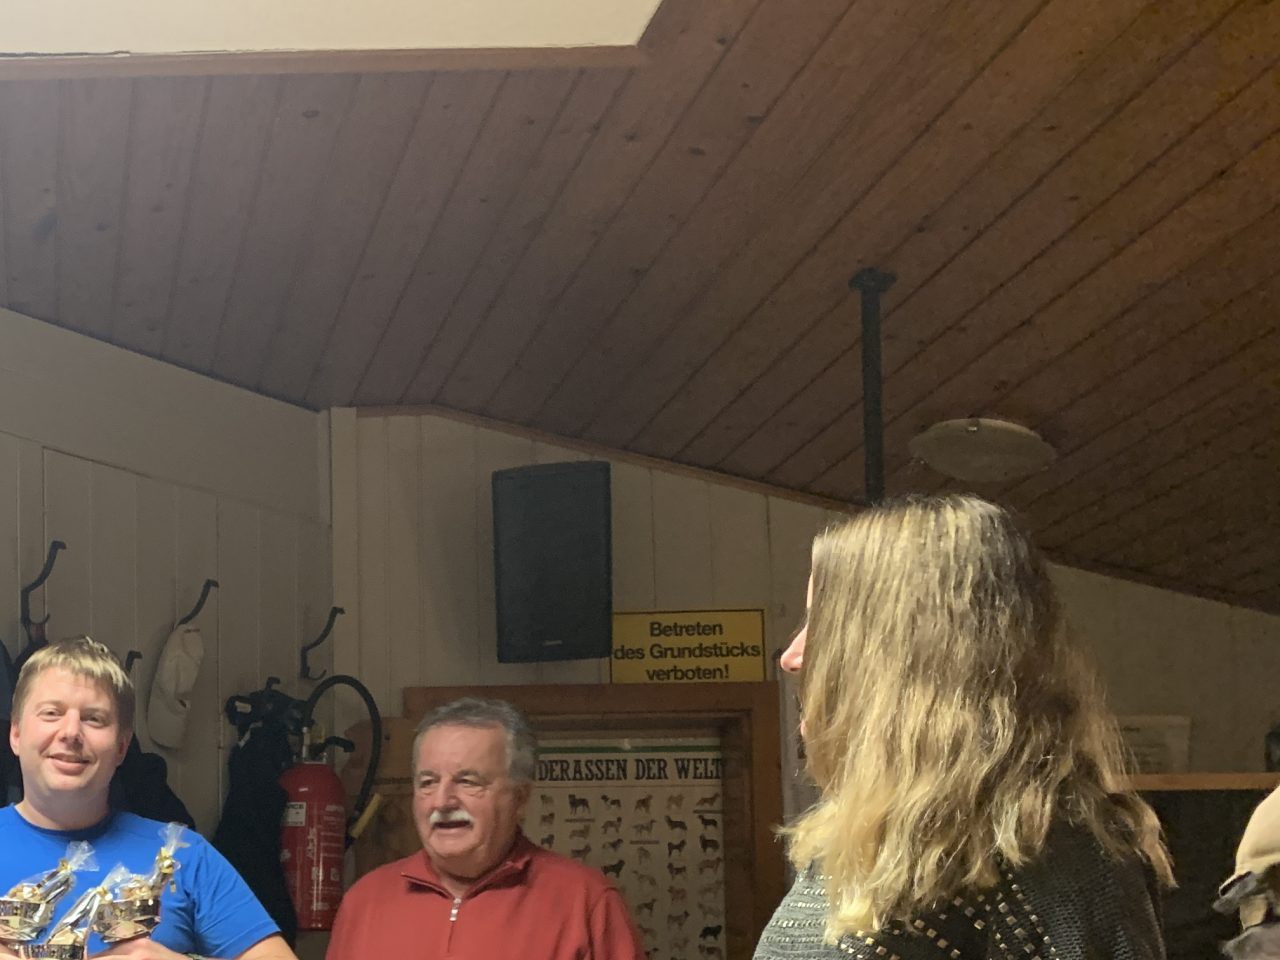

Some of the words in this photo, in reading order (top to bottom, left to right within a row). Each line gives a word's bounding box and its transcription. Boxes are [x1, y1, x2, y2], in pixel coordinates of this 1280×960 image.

[650, 621, 723, 637] Betreten
[614, 645, 645, 660] des
[650, 642, 761, 660] Grundstücks
[646, 664, 729, 681] verboten!
[538, 758, 628, 781] DERASSEN
[634, 758, 668, 781] DER
[674, 757, 721, 780] WELT
